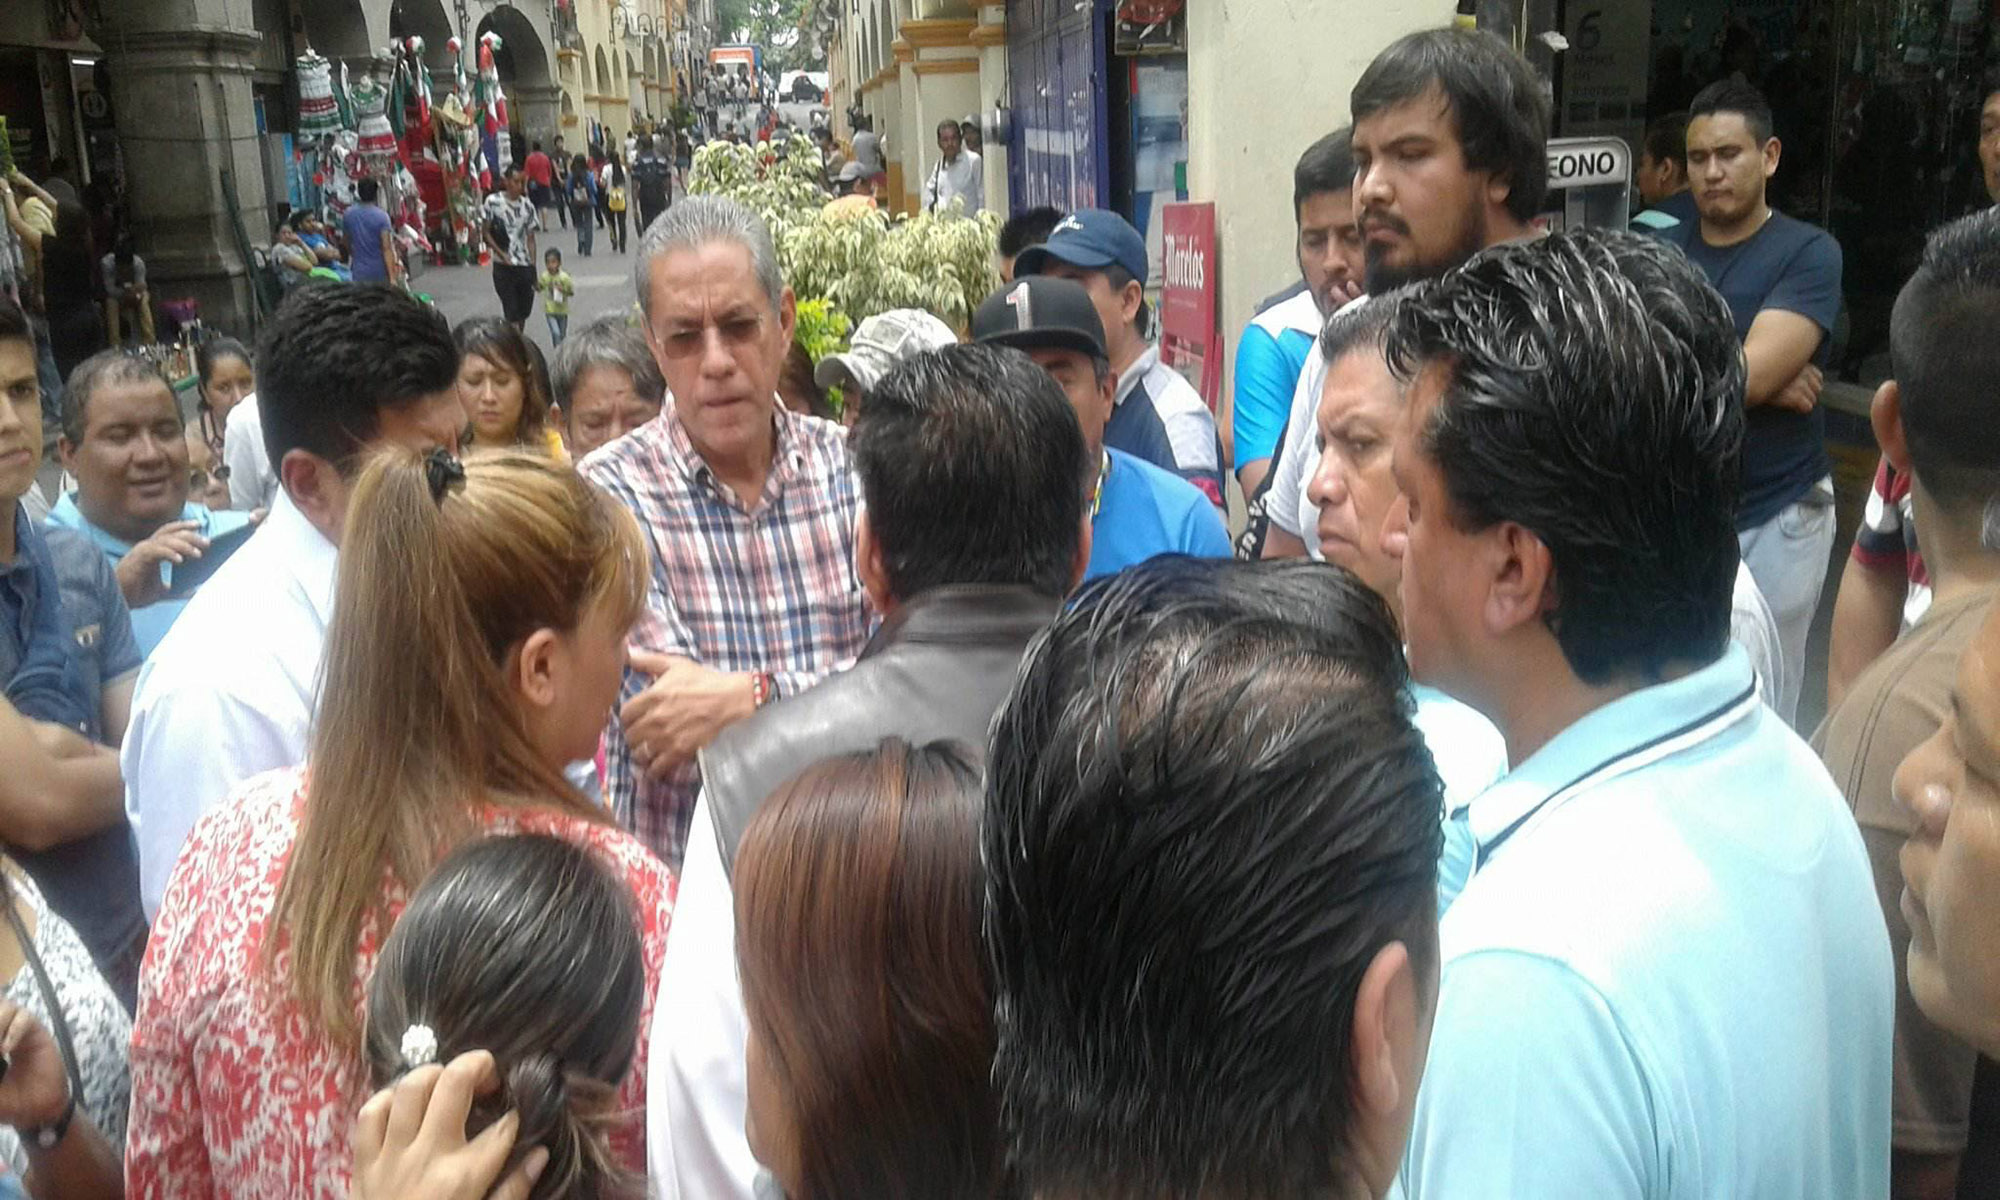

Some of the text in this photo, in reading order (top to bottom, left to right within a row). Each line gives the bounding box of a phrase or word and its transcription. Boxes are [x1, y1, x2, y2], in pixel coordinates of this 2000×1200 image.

[1576, 10, 1602, 51] 6
[1164, 233, 1204, 290] Morelos
[1006, 282, 1033, 331] 1
